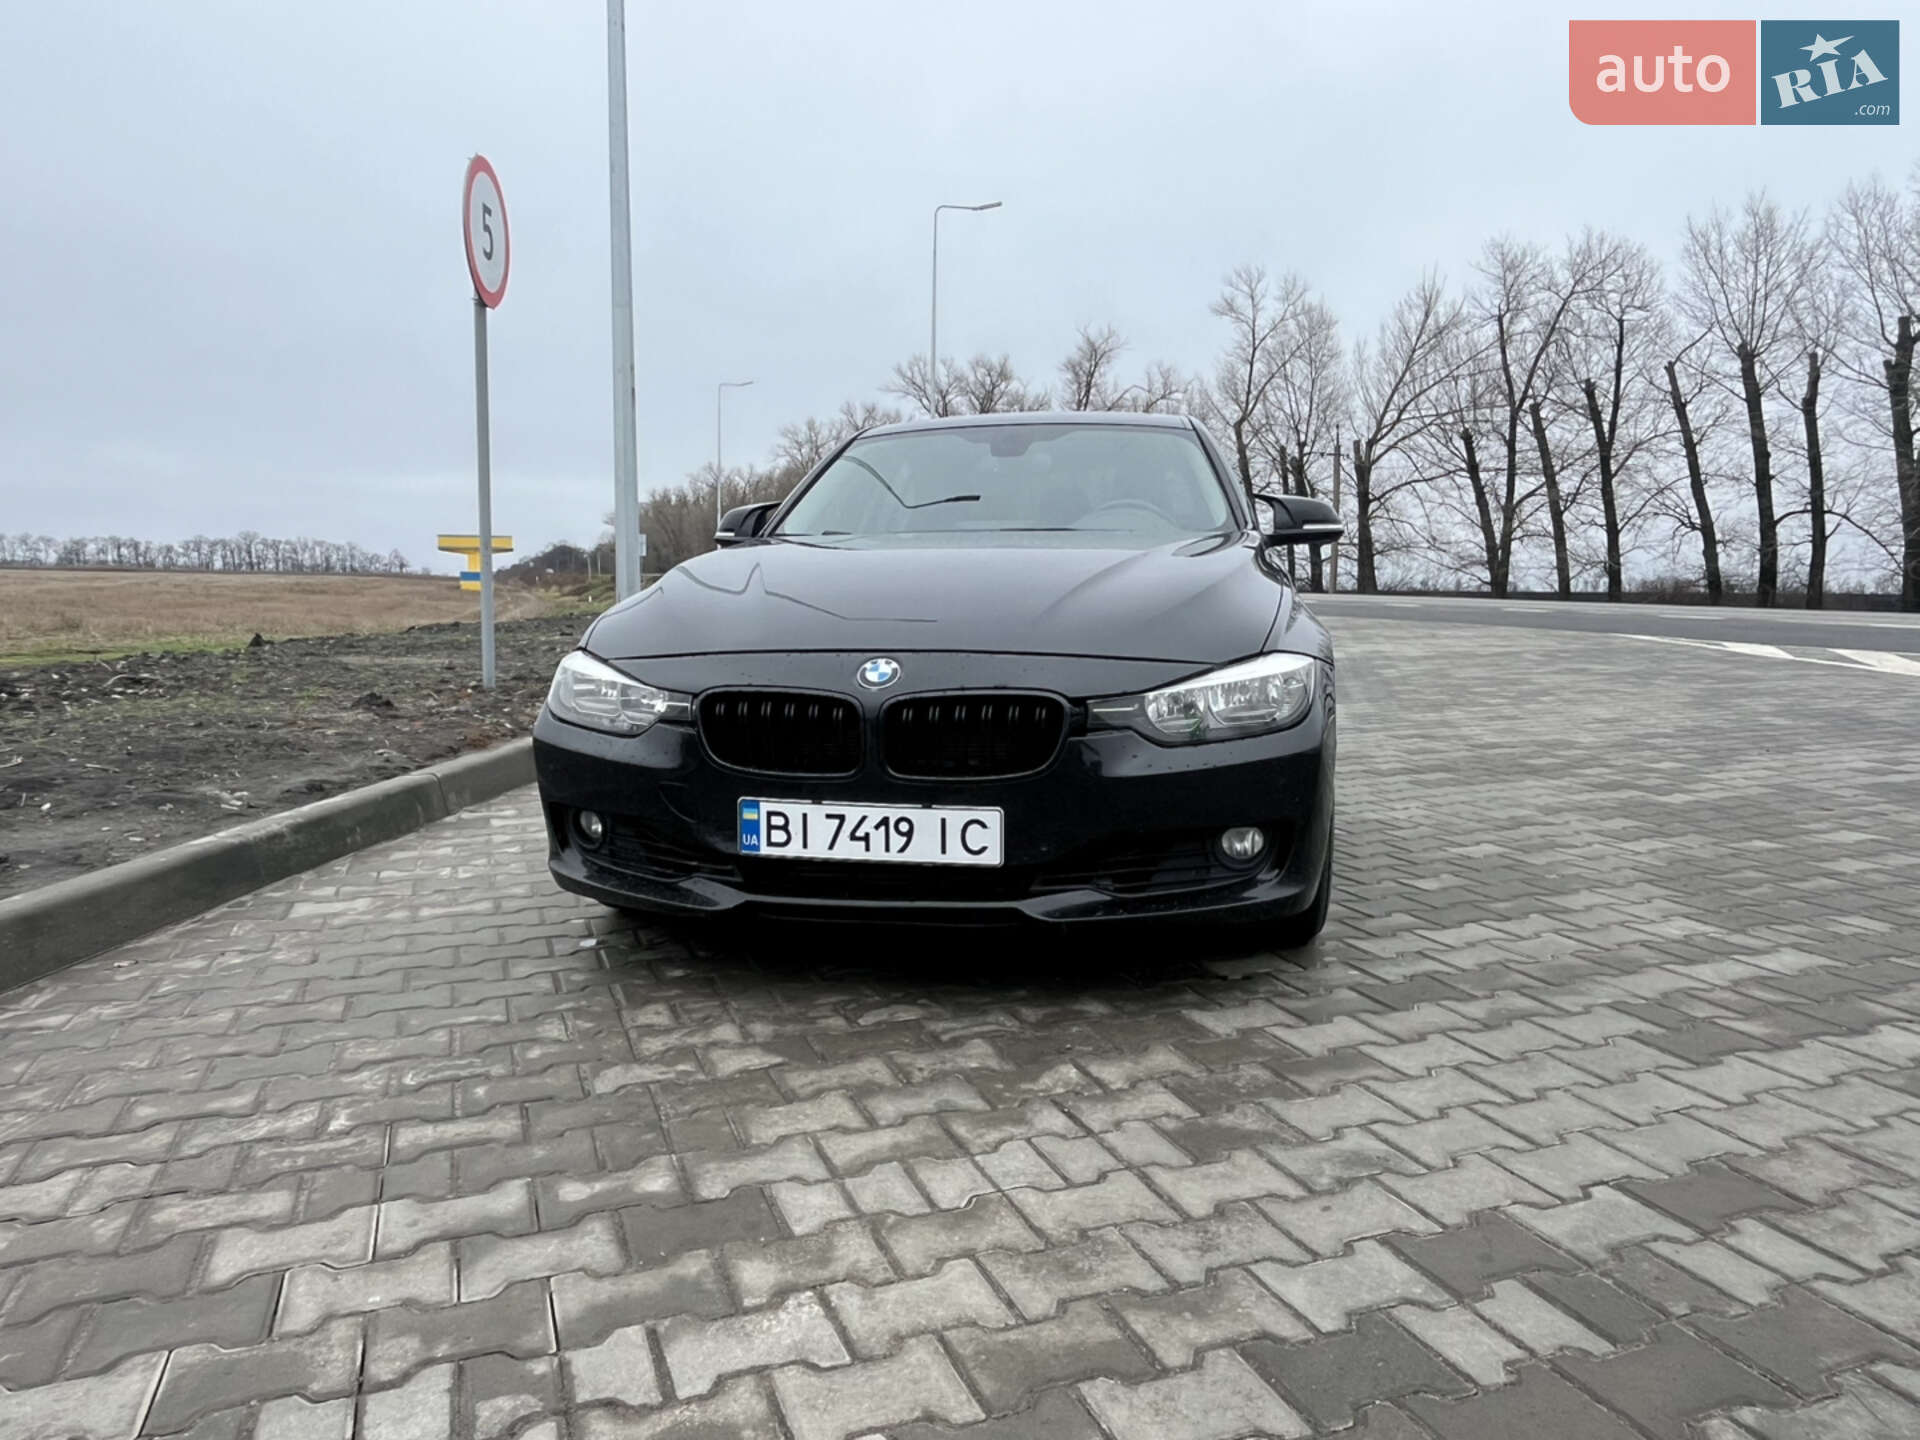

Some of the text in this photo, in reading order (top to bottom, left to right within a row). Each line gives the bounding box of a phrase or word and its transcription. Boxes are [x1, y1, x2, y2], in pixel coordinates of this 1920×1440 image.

[482, 202, 494, 261] 5
[742, 833, 759, 846] UA
[765, 810, 989, 856] BI 7419 IC
